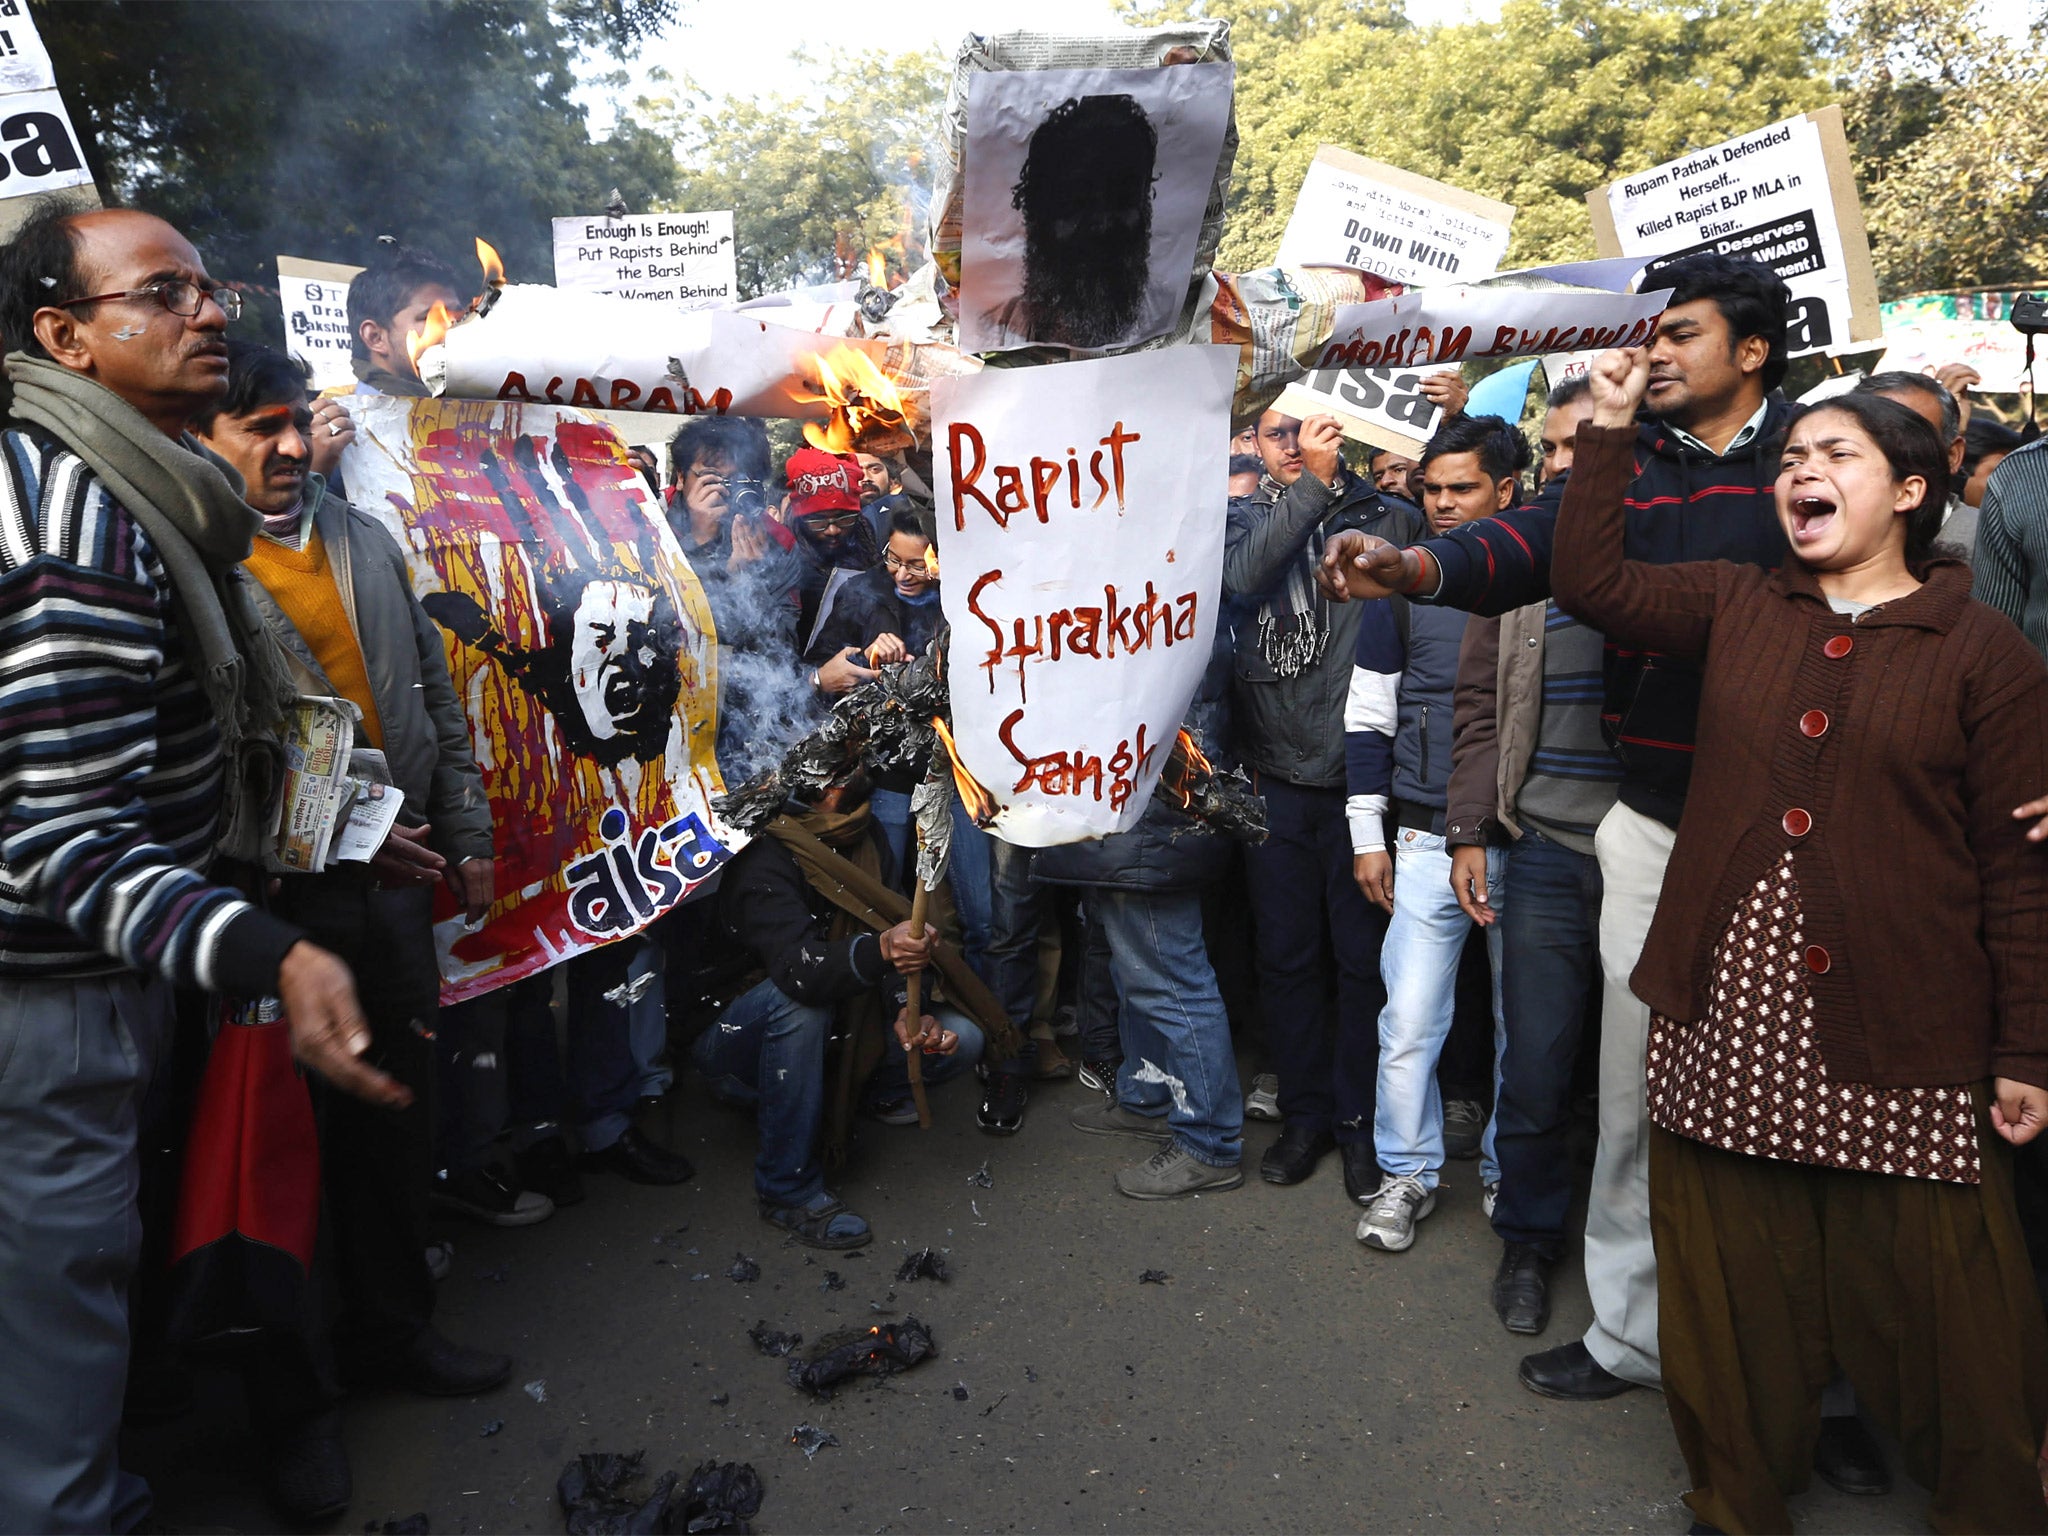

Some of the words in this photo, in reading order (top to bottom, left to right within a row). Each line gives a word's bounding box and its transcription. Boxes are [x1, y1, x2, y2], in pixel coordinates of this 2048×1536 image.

[0, 112, 82, 182] a
[1624, 171, 1670, 199] Rupam
[1671, 154, 1720, 182] Pathak
[1723, 127, 1791, 163] Defended
[1636, 216, 1673, 238] Killed
[1675, 202, 1719, 229] Rapist
[1720, 190, 1748, 211] BJP
[1752, 178, 1786, 200] MLA
[1788, 175, 1802, 189] in
[1679, 172, 1741, 201] Herself...
[586, 223, 636, 242] Enough
[641, 222, 653, 237] Is
[658, 220, 710, 239] Enough!
[1331, 180, 1359, 194] own
[1441, 214, 1494, 242] olicing
[1346, 199, 1367, 212] and
[1376, 208, 1414, 228] ictim
[1419, 226, 1468, 249] laming
[578, 247, 603, 261] Put
[610, 246, 663, 263] Rapists
[670, 241, 718, 257] Behind
[1344, 218, 1403, 254] Down
[1408, 240, 1460, 274] With
[1717, 219, 1806, 256] Deserves
[1752, 237, 1809, 263] AWARD
[616, 265, 642, 280] the
[649, 262, 685, 278] Bars!
[680, 284, 728, 299] Behind
[306, 335, 331, 348] For
[1319, 326, 1472, 368] MOHAN
[497, 370, 733, 415] ASARAM
[947, 420, 1140, 532] Rapist
[968, 568, 1197, 672] Suraksha
[323, 732, 335, 769] HOUSE
[1000, 708, 1158, 813] Sangh
[566, 809, 738, 932] aisa
